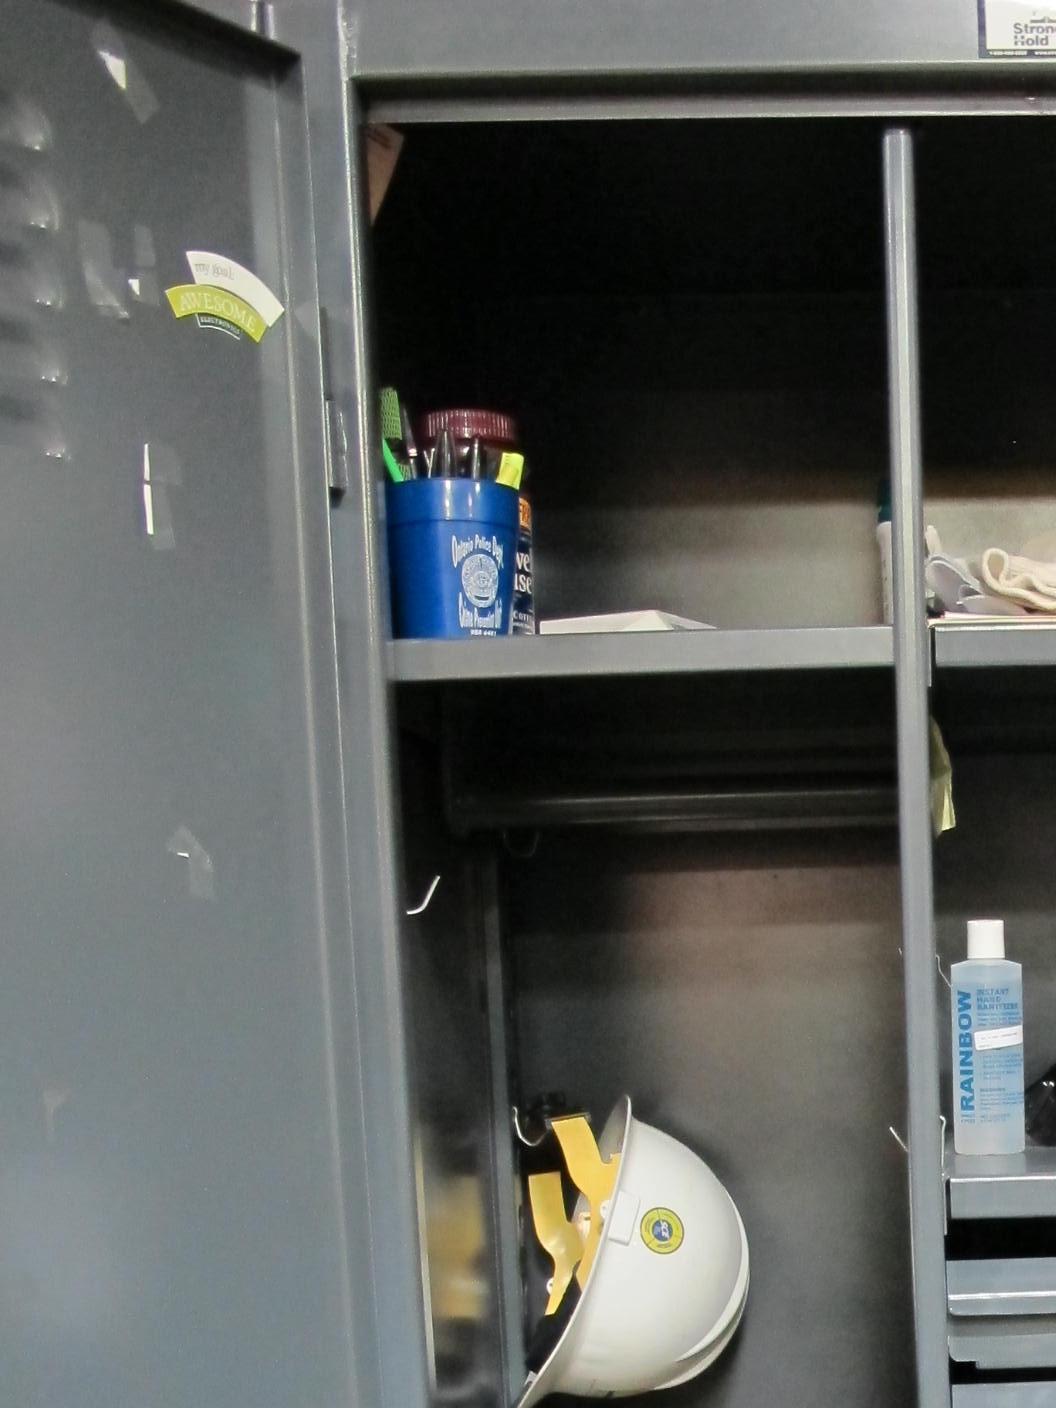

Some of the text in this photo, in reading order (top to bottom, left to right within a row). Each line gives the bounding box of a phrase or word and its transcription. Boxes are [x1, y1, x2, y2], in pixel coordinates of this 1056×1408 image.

[1014, 35, 1049, 46] Hold
[179, 291, 256, 333] AWESOME
[451, 534, 473, 568] Ontario
[474, 533, 491, 552] Police
[957, 990, 976, 1111] RAINBOW
